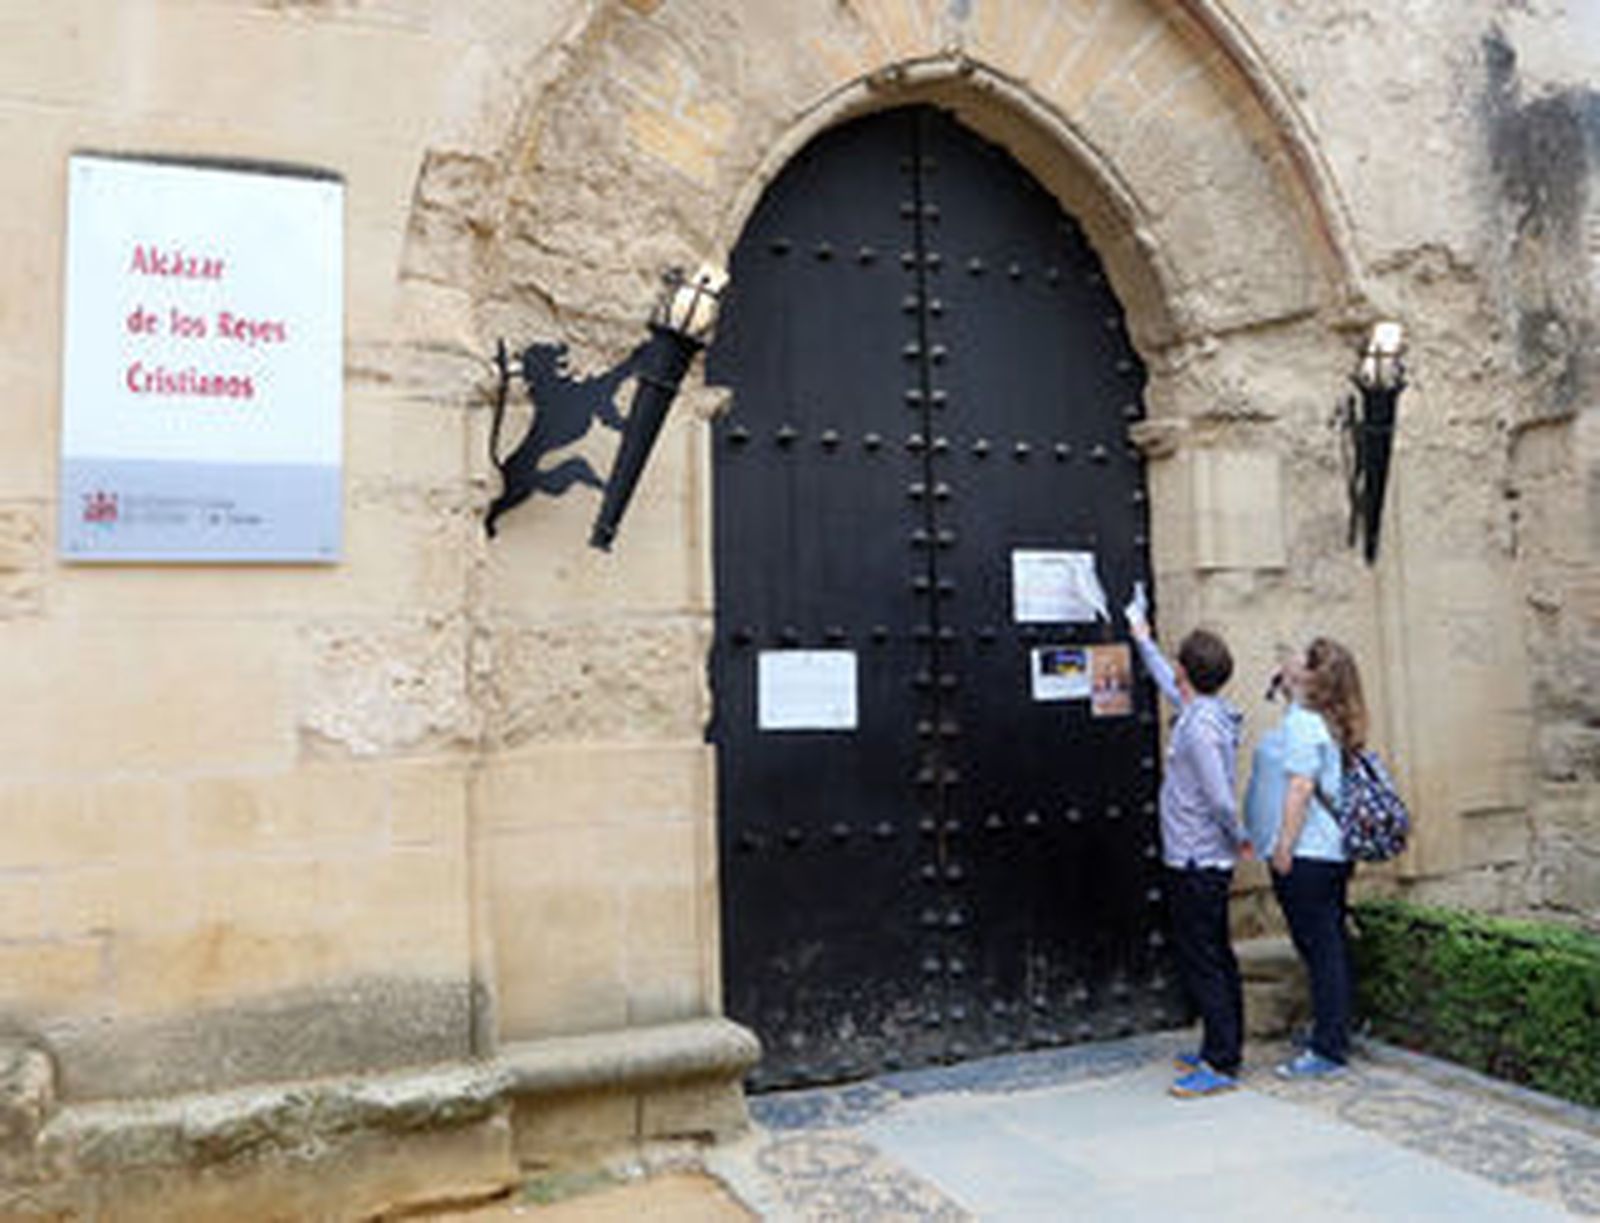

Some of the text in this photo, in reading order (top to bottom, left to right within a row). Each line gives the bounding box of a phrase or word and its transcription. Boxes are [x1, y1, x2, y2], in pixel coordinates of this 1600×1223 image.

[130, 243, 225, 280] Alcázar
[126, 306, 287, 346] de los Reyes
[126, 361, 255, 399] Cristianos
